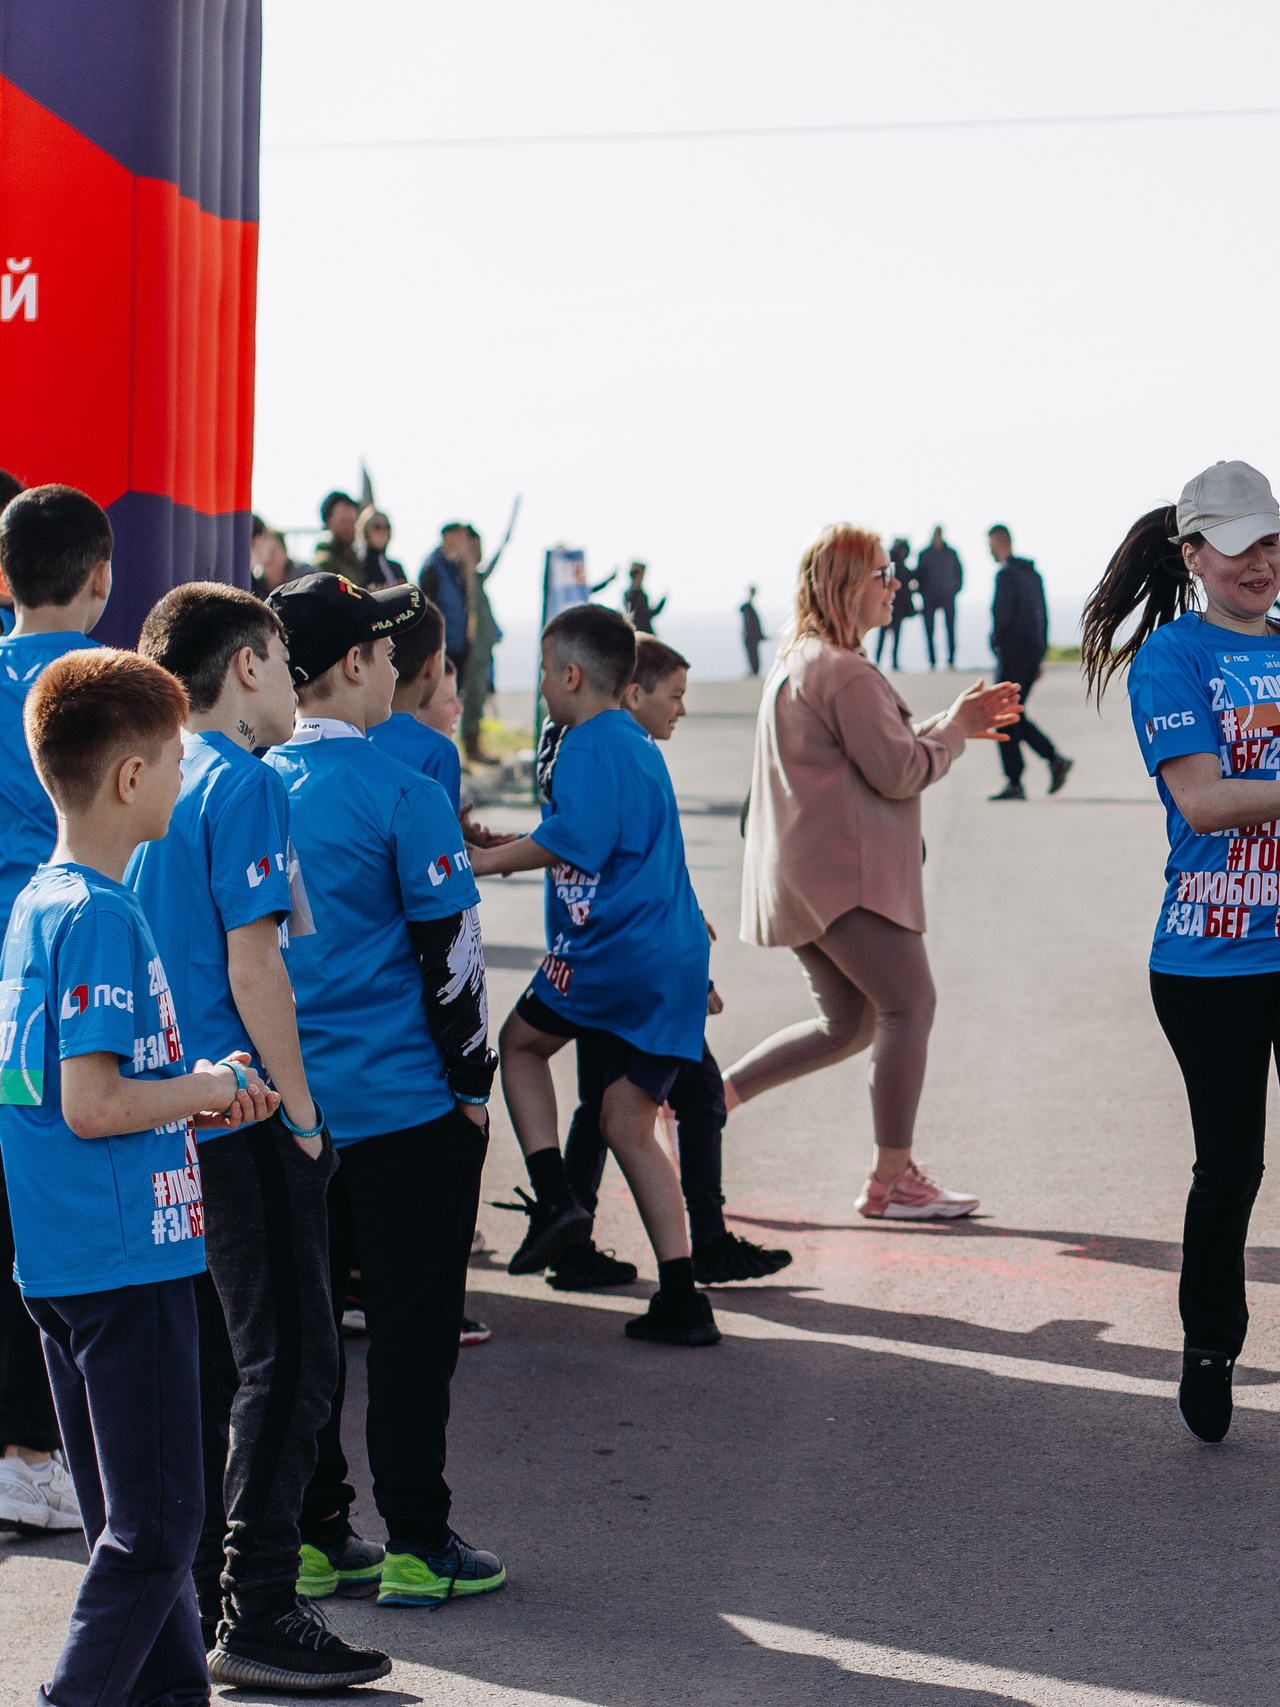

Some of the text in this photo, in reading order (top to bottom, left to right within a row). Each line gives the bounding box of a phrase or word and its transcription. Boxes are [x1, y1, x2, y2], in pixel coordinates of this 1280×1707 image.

[410, 591, 420, 608] FILA
[394, 609, 415, 624] FILA
[371, 619, 393, 632] FILA
[1153, 711, 1196, 731] ПСБ
[1166, 902, 1250, 938] #ЗАБЕГ
